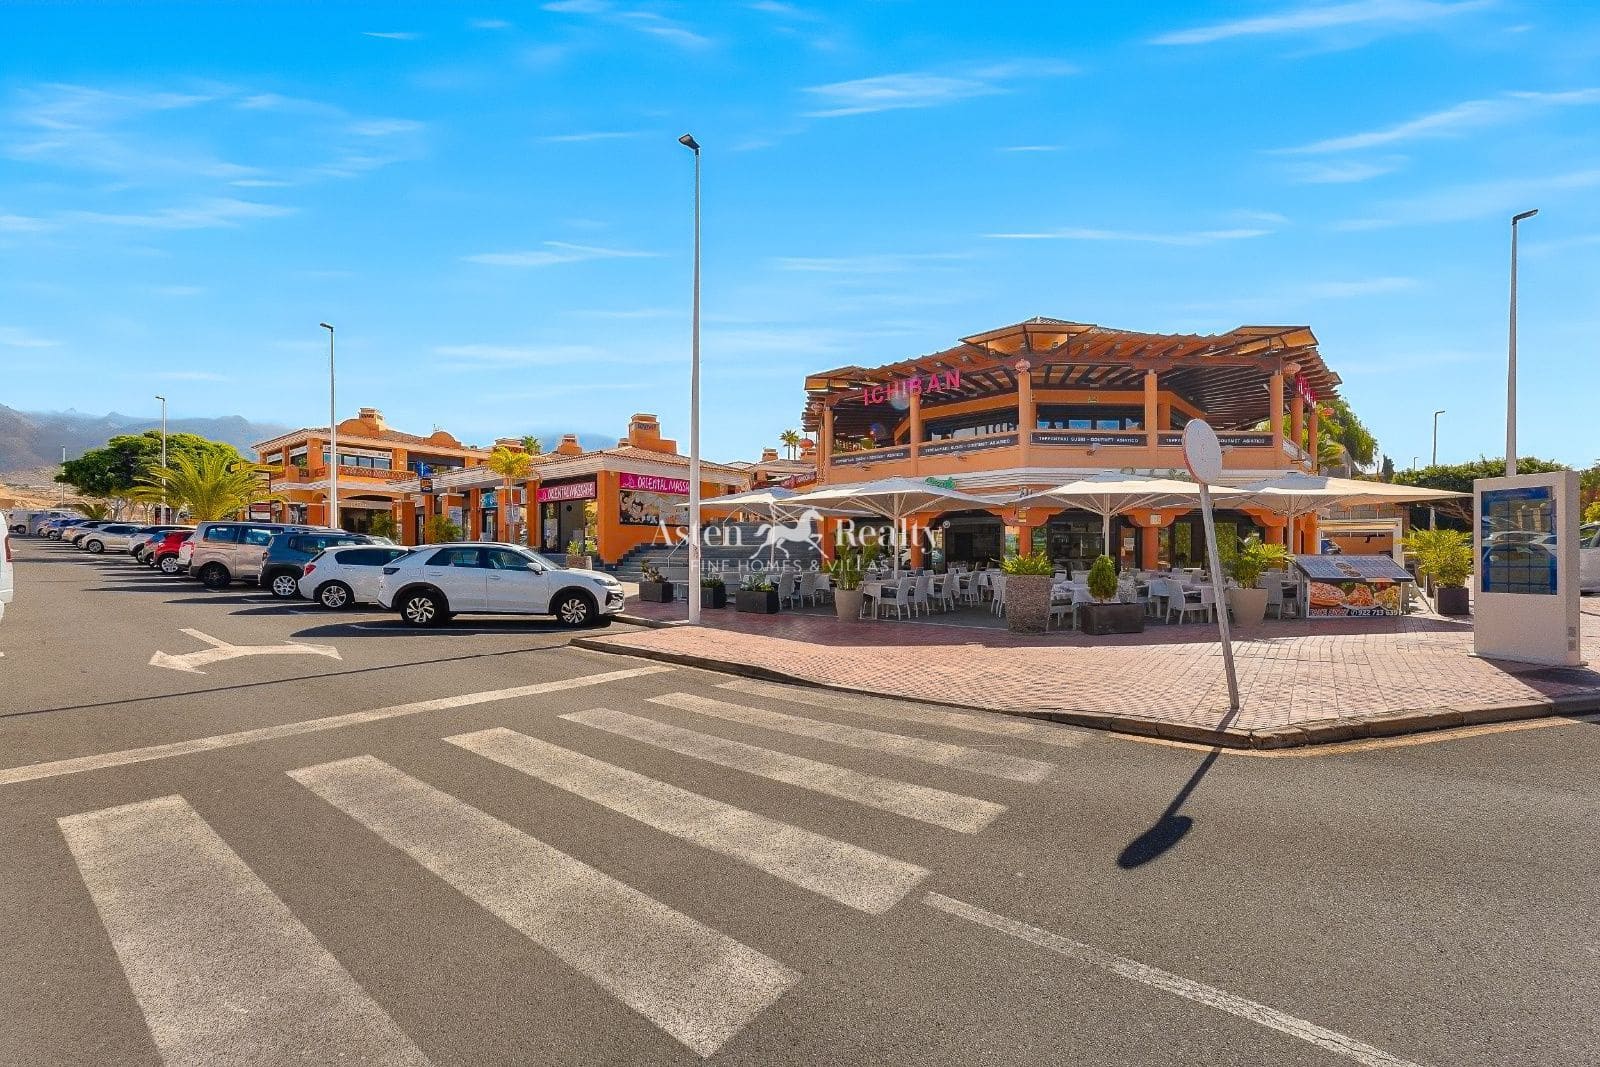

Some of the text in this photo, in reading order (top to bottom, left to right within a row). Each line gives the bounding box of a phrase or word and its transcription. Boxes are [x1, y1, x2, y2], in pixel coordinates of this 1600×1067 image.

[863, 368, 962, 407] ICHIBAN
[638, 476, 690, 493] ORIENTAL MASSA
